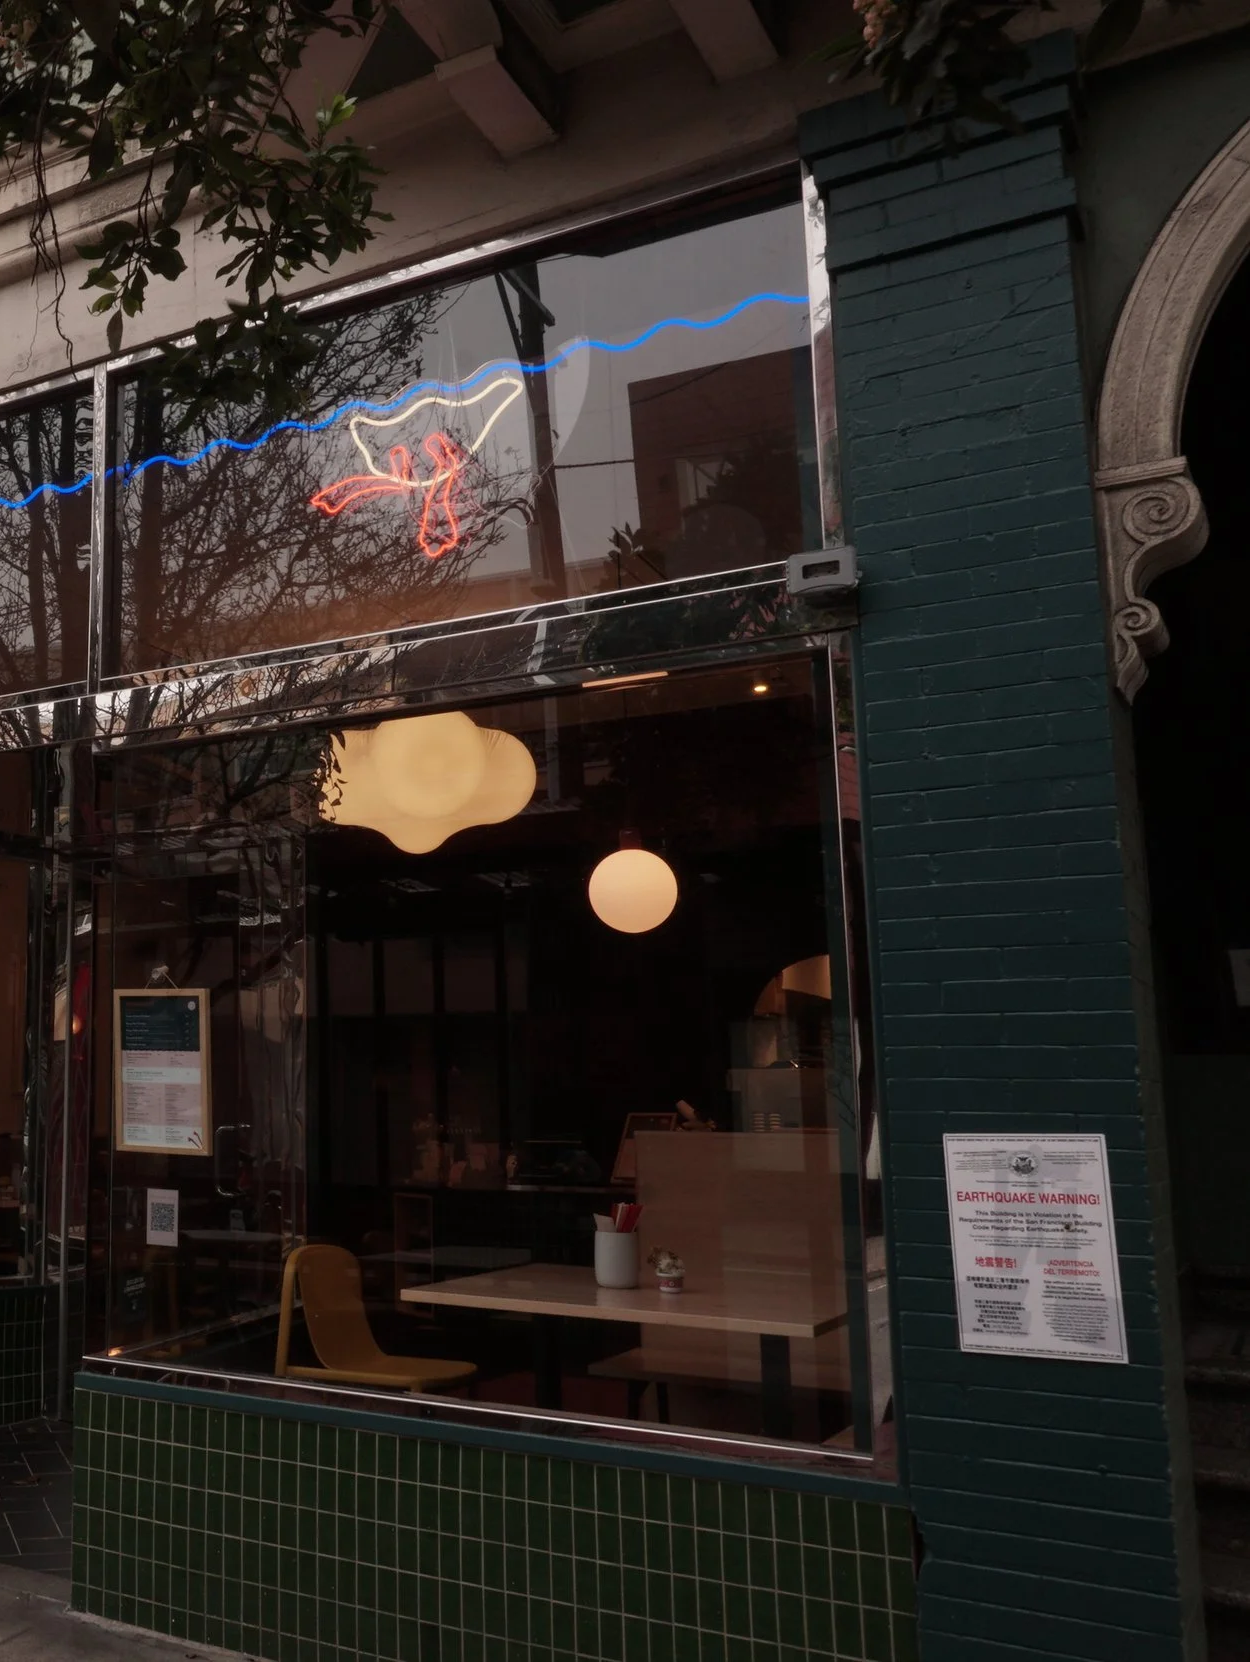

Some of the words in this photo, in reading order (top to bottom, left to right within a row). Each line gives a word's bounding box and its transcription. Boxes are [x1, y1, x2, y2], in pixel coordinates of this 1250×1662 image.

[957, 1191, 1035, 1204] EARTHQUAKE
[1039, 1192, 1101, 1205] WARNING!
[990, 1210, 1017, 1218] Building
[1074, 1220, 1102, 1228] Building
